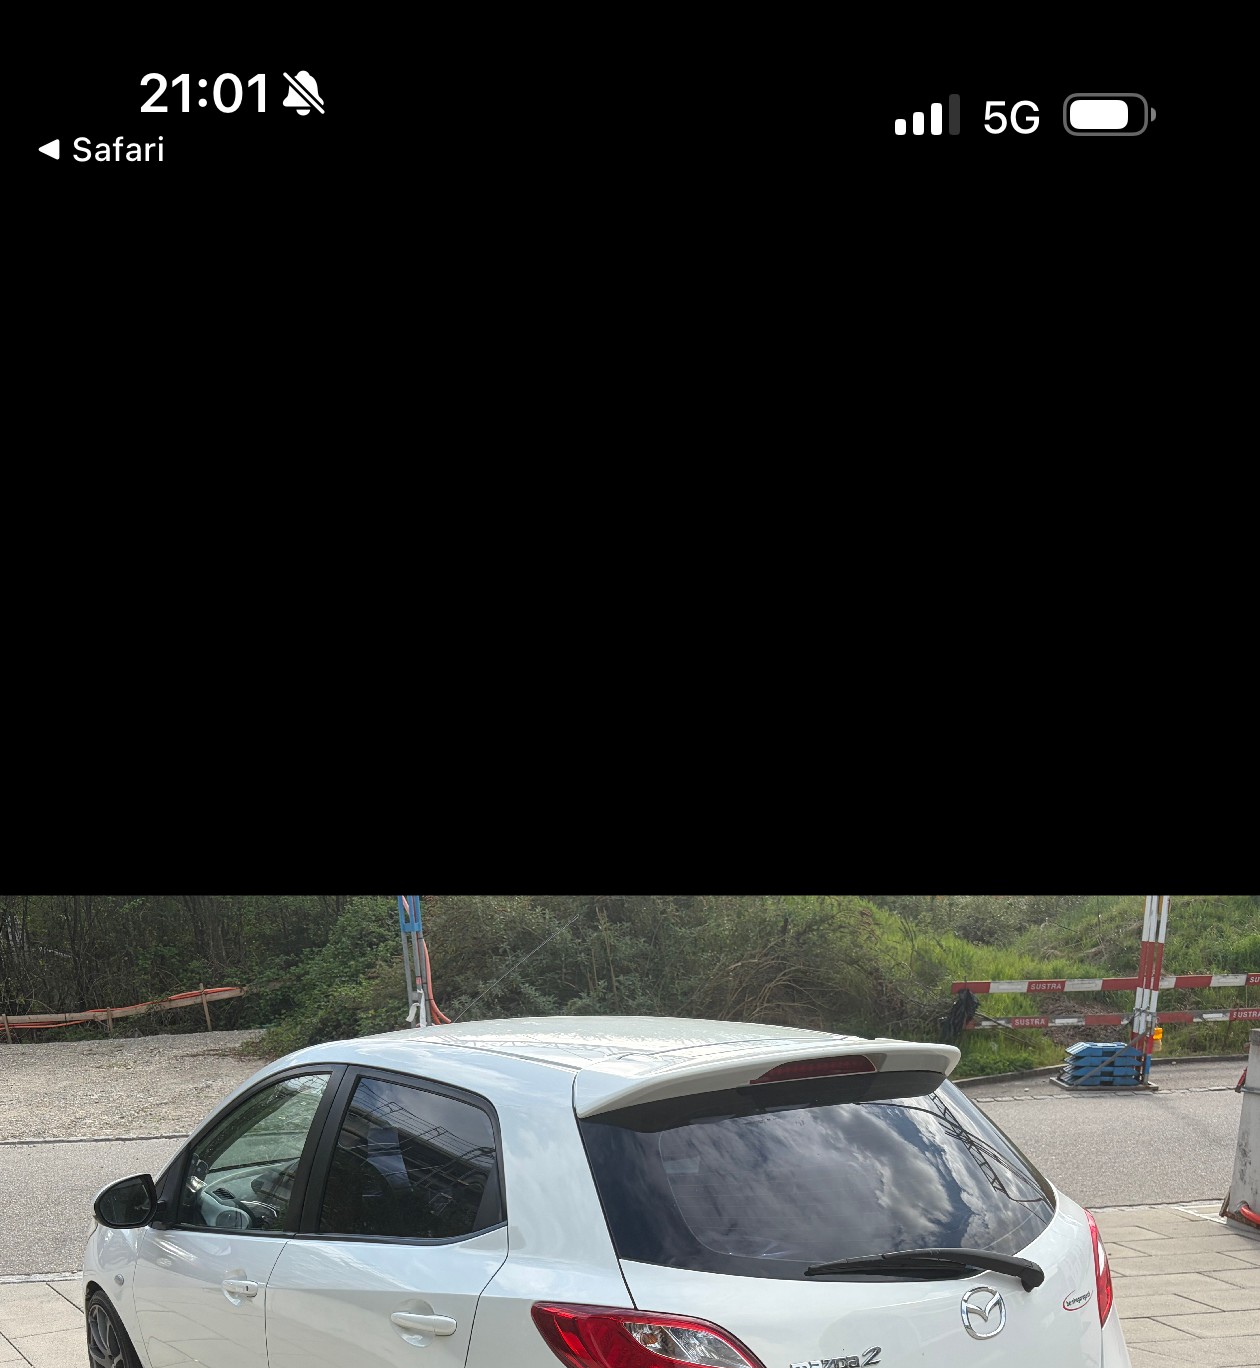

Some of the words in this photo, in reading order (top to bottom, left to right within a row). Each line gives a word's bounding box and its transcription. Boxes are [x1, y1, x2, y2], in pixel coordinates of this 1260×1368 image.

[1030, 983, 1062, 991] SUSTRA
[1014, 1018, 1045, 1026] SUSTRA
[860, 1345, 881, 1368] 2
